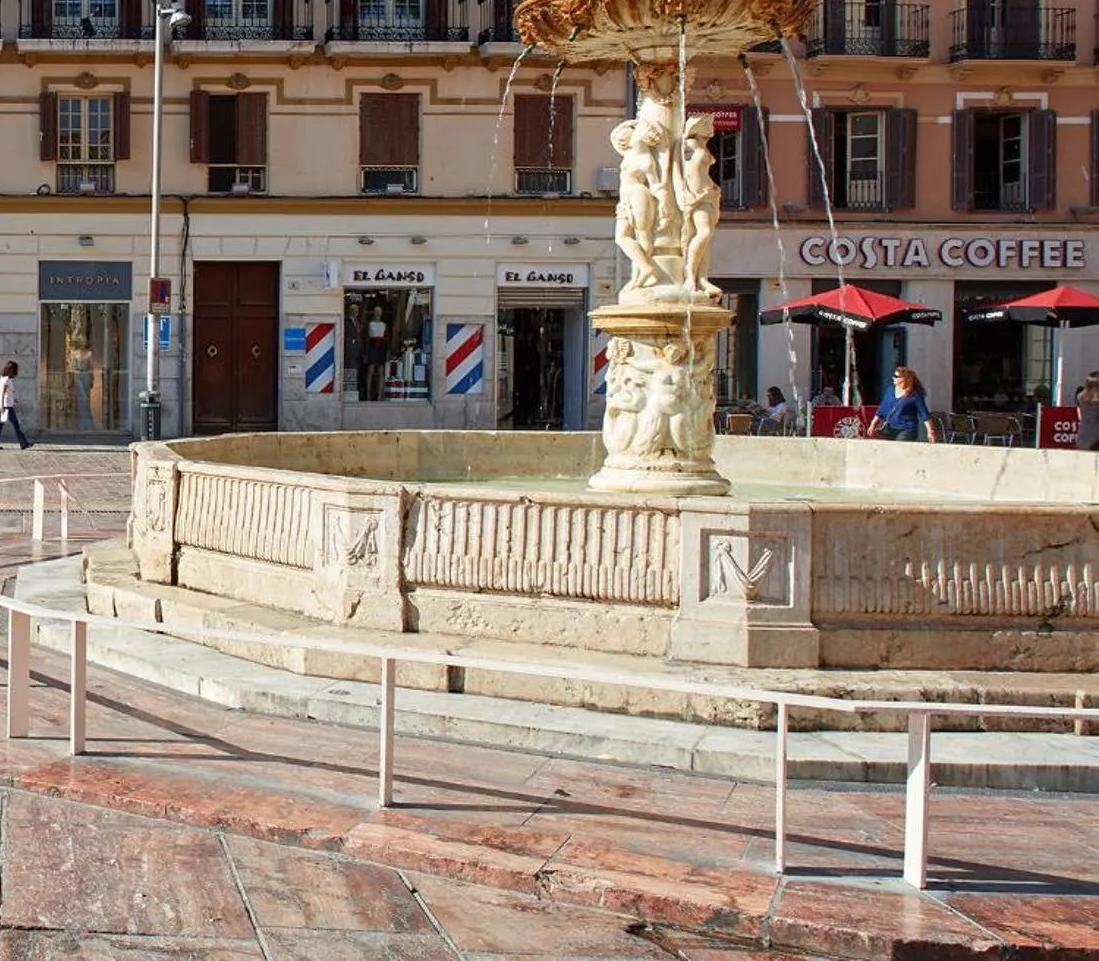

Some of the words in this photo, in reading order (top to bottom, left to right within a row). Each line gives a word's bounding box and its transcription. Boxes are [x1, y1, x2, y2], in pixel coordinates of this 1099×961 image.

[800, 237, 931, 270] COSTA
[938, 238, 1086, 269] COFFEE
[49, 276, 120, 285] INTROPIA
[353, 270, 371, 282] EL
[374, 269, 425, 283] GANSO
[505, 271, 522, 282] EL
[526, 271, 574, 284] GANSO
